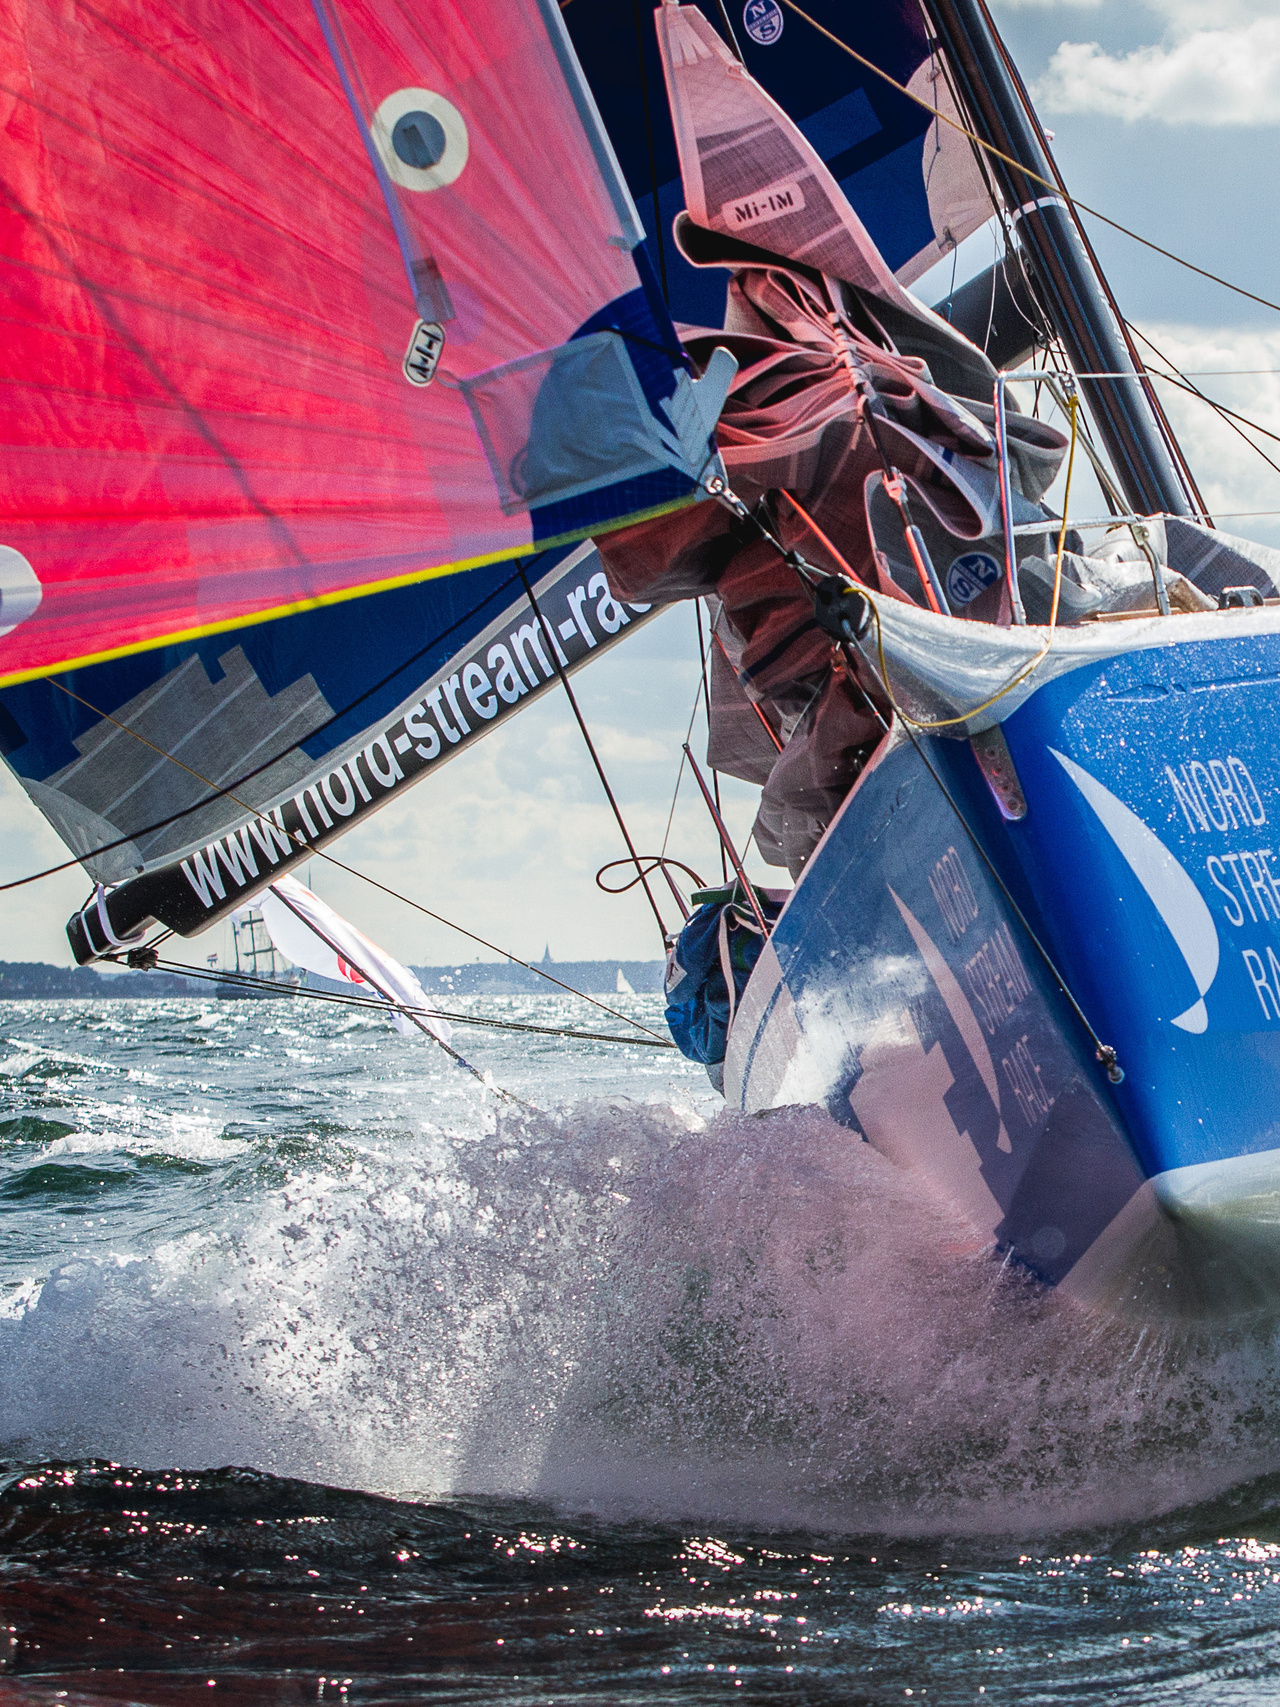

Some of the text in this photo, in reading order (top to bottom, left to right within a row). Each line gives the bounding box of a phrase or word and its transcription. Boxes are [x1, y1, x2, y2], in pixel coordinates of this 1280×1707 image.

[180, 572, 652, 909] www.nord-stream-ra
[1165, 757, 1266, 834] NORD
[927, 846, 979, 944] NORD
[964, 921, 1033, 1035] STREAM
[1002, 1034, 1056, 1135] RACE
